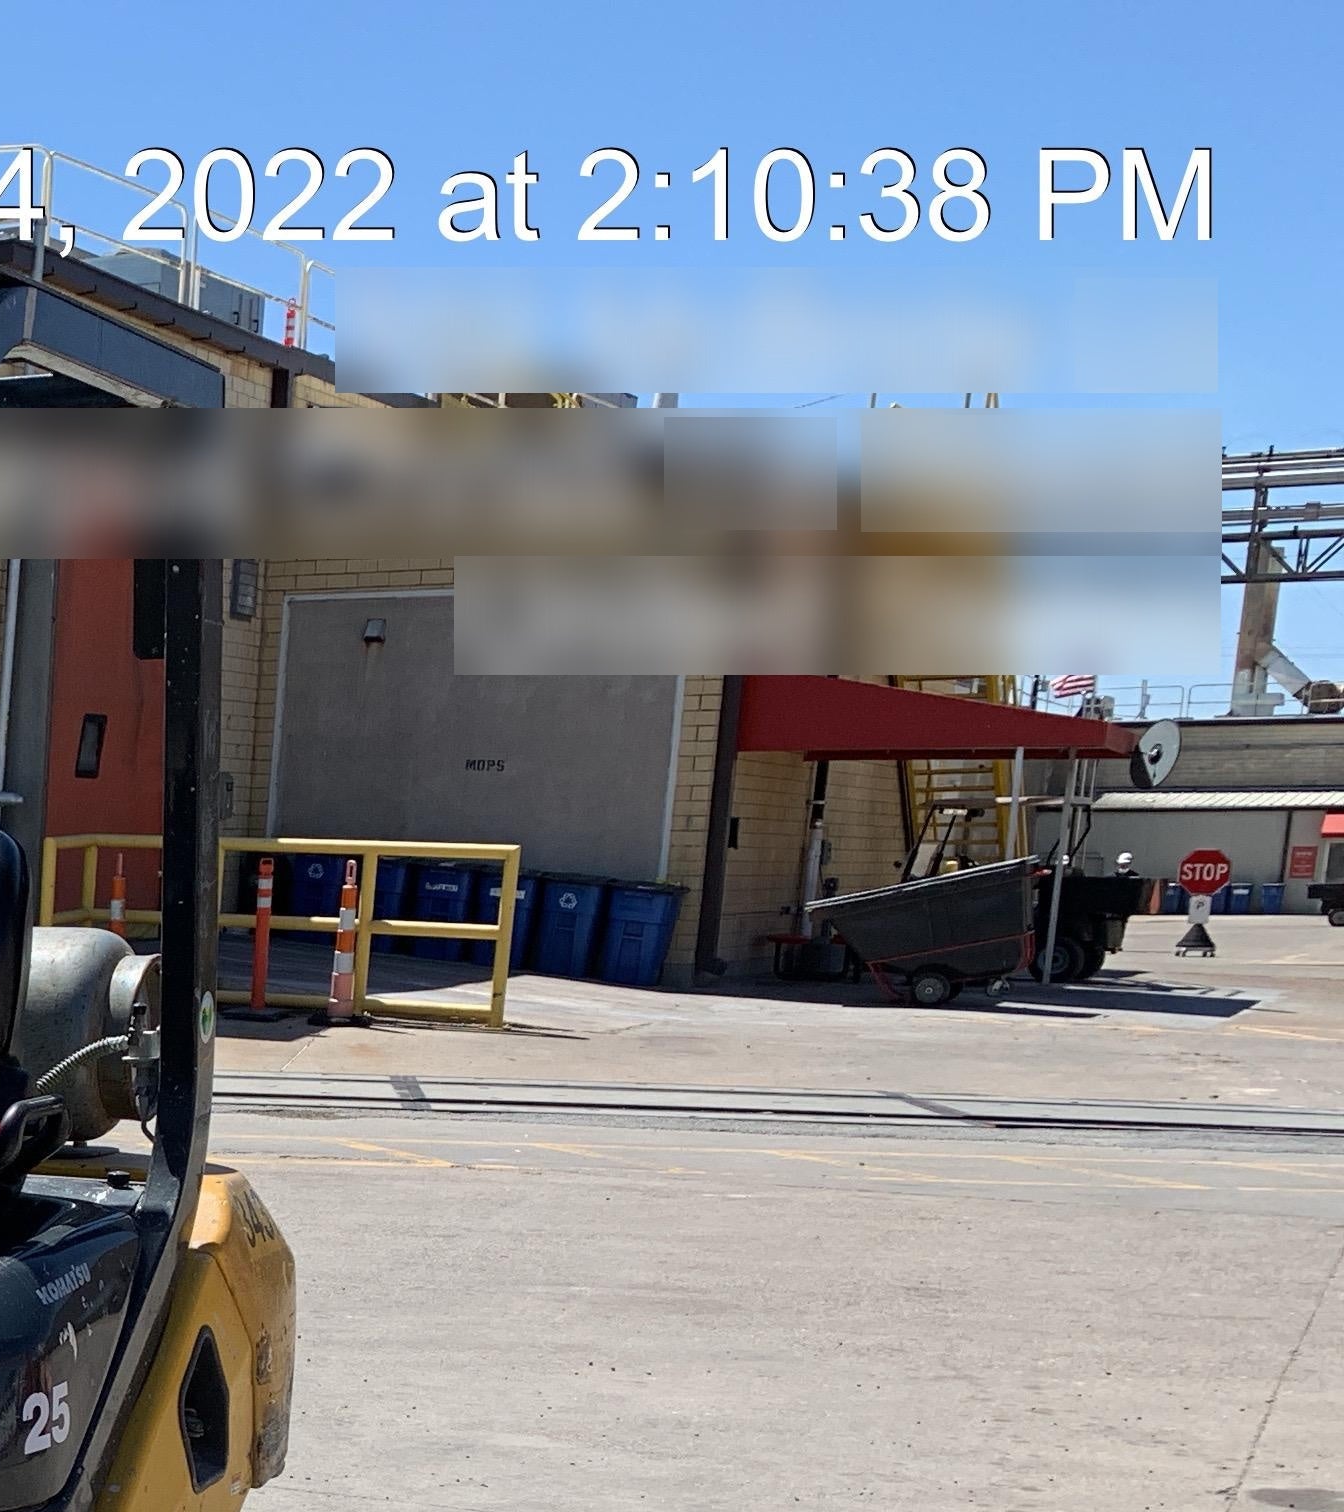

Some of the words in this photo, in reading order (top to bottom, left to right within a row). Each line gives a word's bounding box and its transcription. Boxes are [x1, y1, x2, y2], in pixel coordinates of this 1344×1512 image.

[465, 759, 505, 772] MOPS
[1181, 862, 1229, 881] STOP
[35, 1262, 91, 1305] KOMATSU
[22, 1380, 71, 1455] 25
